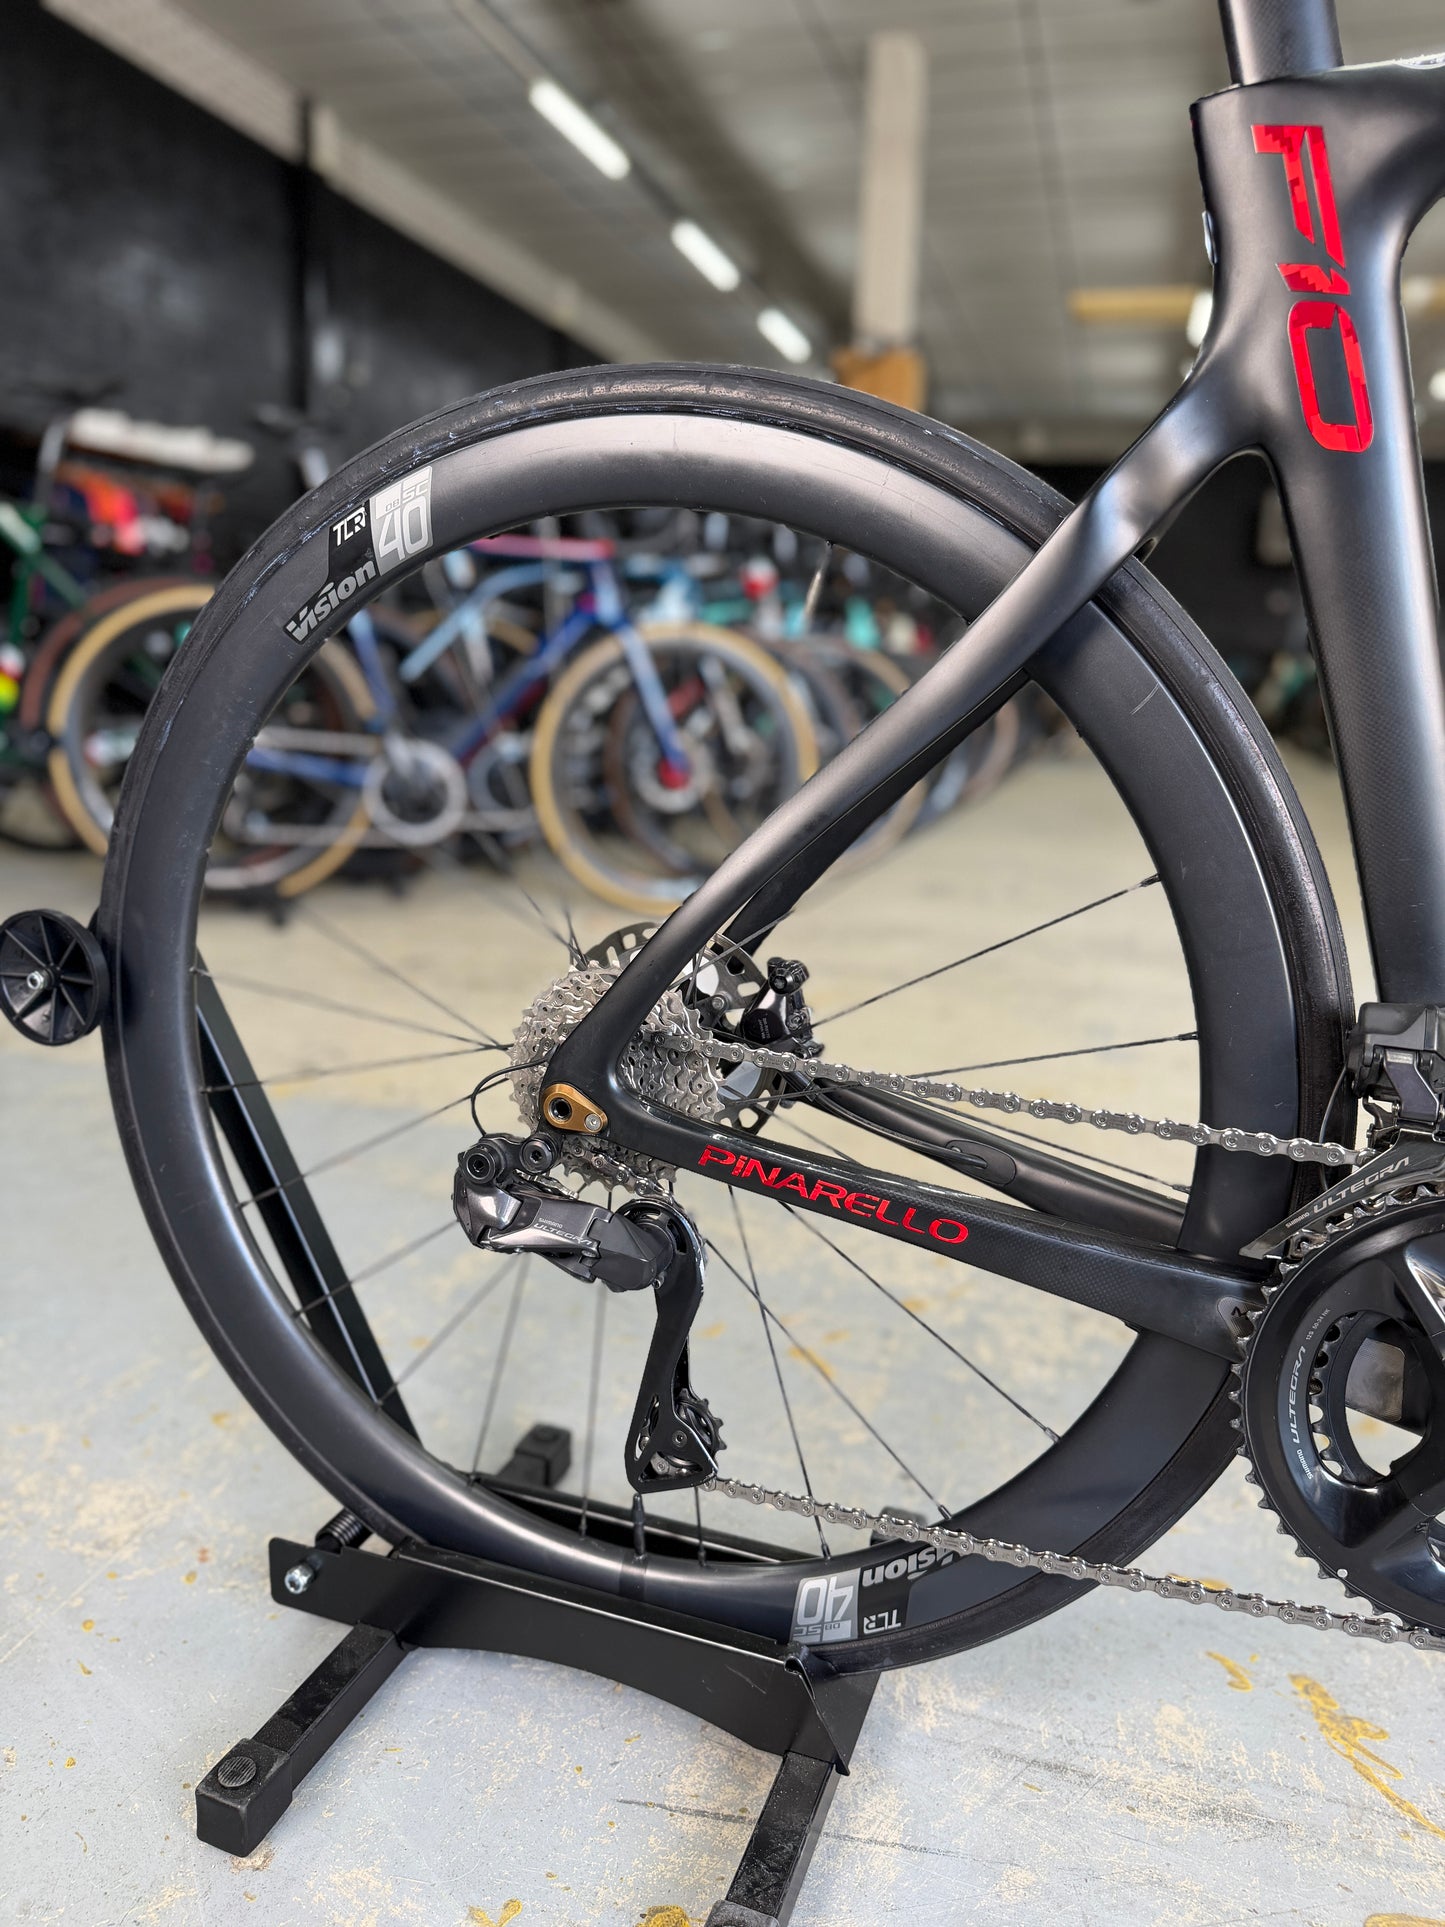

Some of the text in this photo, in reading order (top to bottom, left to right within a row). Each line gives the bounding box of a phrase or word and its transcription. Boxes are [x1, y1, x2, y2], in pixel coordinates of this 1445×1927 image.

[332, 506, 366, 546] TLR
[378, 496, 429, 561] 40
[1313, 1156, 1410, 1214] ULTEGRA
[533, 1223, 593, 1246] ULTEGRA
[1288, 1345, 1307, 1444] ULTEGRA
[796, 1576, 854, 1625] 40
[863, 1608, 902, 1635] TLR
